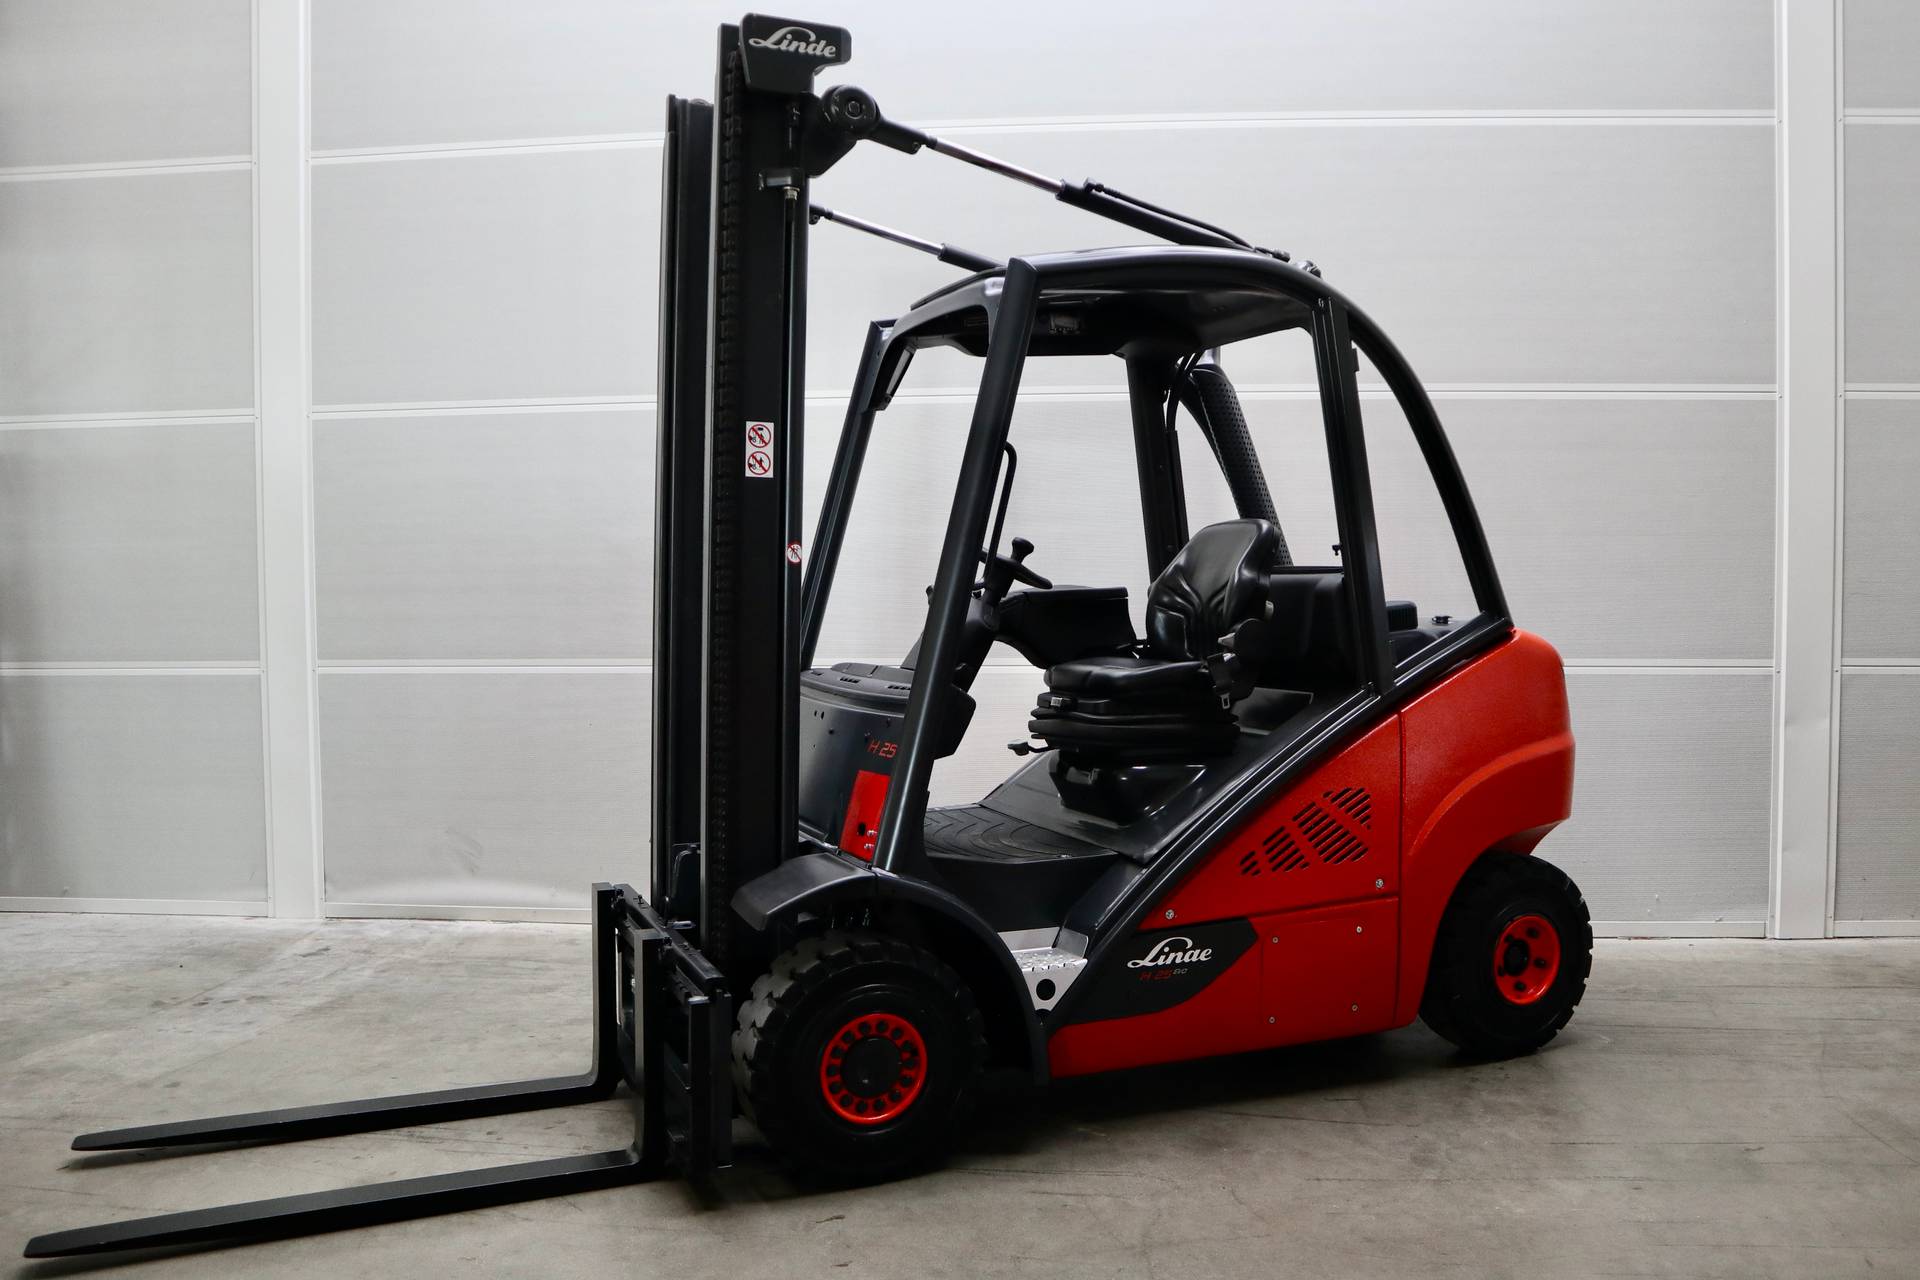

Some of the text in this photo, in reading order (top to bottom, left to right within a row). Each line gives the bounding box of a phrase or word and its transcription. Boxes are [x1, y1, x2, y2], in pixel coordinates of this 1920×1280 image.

[748, 26, 836, 57] Linde
[868, 740, 897, 757] H 25
[1127, 936, 1212, 968] Linde
